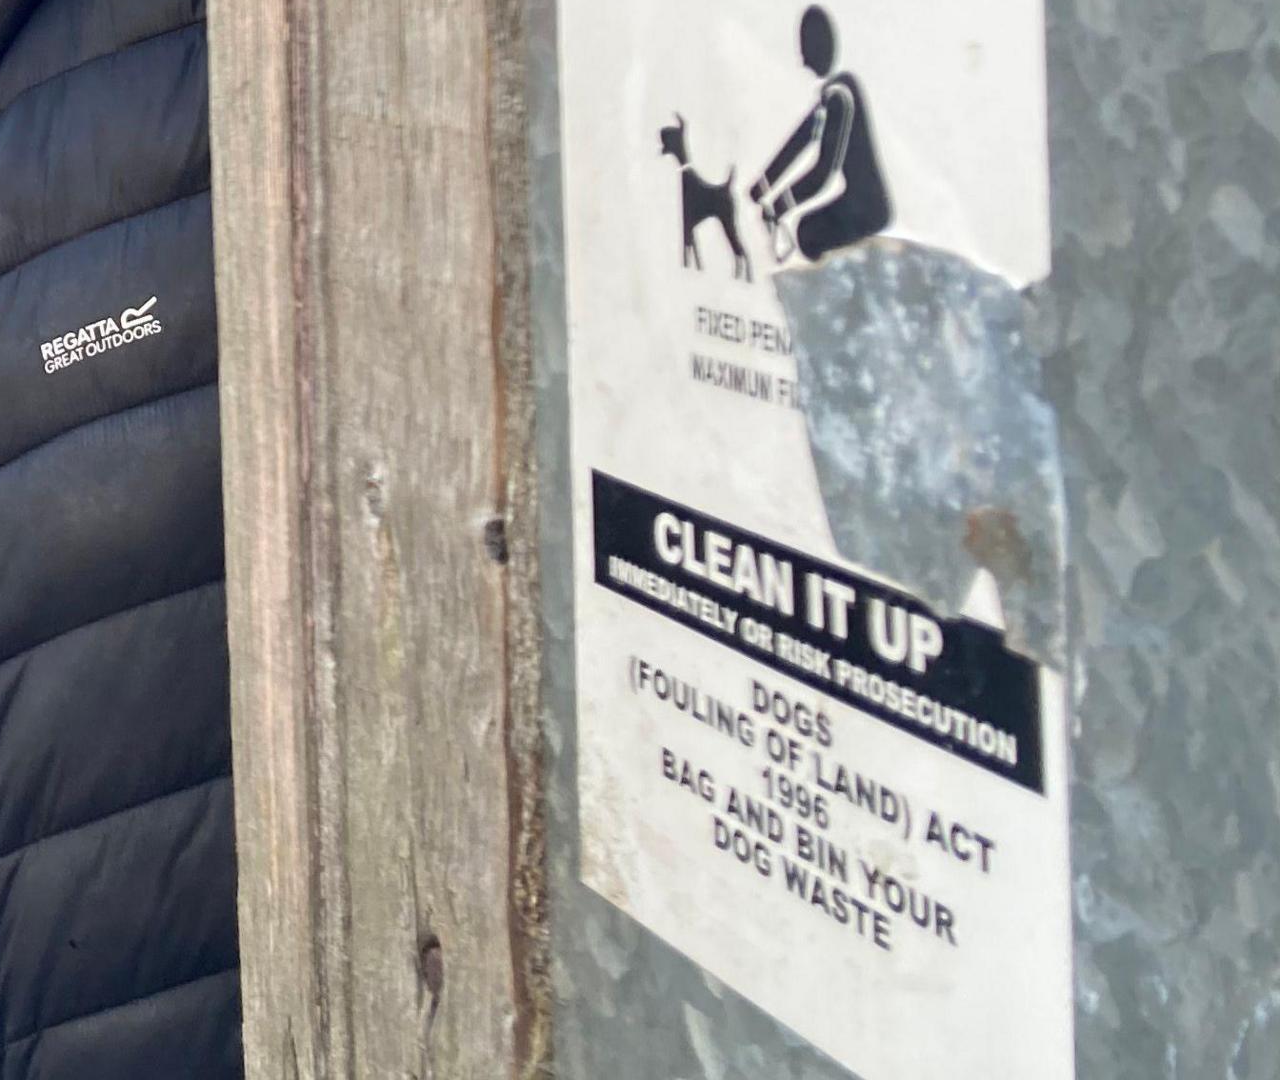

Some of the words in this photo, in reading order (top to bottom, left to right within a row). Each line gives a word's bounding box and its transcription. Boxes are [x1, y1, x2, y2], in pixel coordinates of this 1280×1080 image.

[40, 317, 120, 360] REGATTA
[44, 346, 85, 374] GREAT
[85, 319, 162, 357] OUTDOORS
[695, 305, 745, 344] FIXED
[689, 352, 773, 403] MAXIMUM
[776, 377, 804, 411] FI
[653, 511, 794, 618] CLEAN
[804, 571, 855, 640] IT
[866, 597, 944, 675] UP
[607, 554, 738, 636] IMMEDIATELY
[738, 616, 774, 653] OR
[774, 631, 832, 680] RISK
[832, 658, 1018, 767] PROSECUTION
[751, 679, 834, 748] DOGS
[628, 655, 756, 748] (FOULING
[765, 728, 803, 771] OF
[812, 751, 912, 840] LAND)
[925, 810, 995, 873] ACT
[761, 766, 830, 831] 1996
[661, 746, 716, 803] BAG
[726, 787, 784, 844] AND
[796, 823, 849, 883] BIN
[858, 858, 959, 947] YOUR
[713, 816, 773, 878] DOG
[782, 854, 892, 951] WASTE
